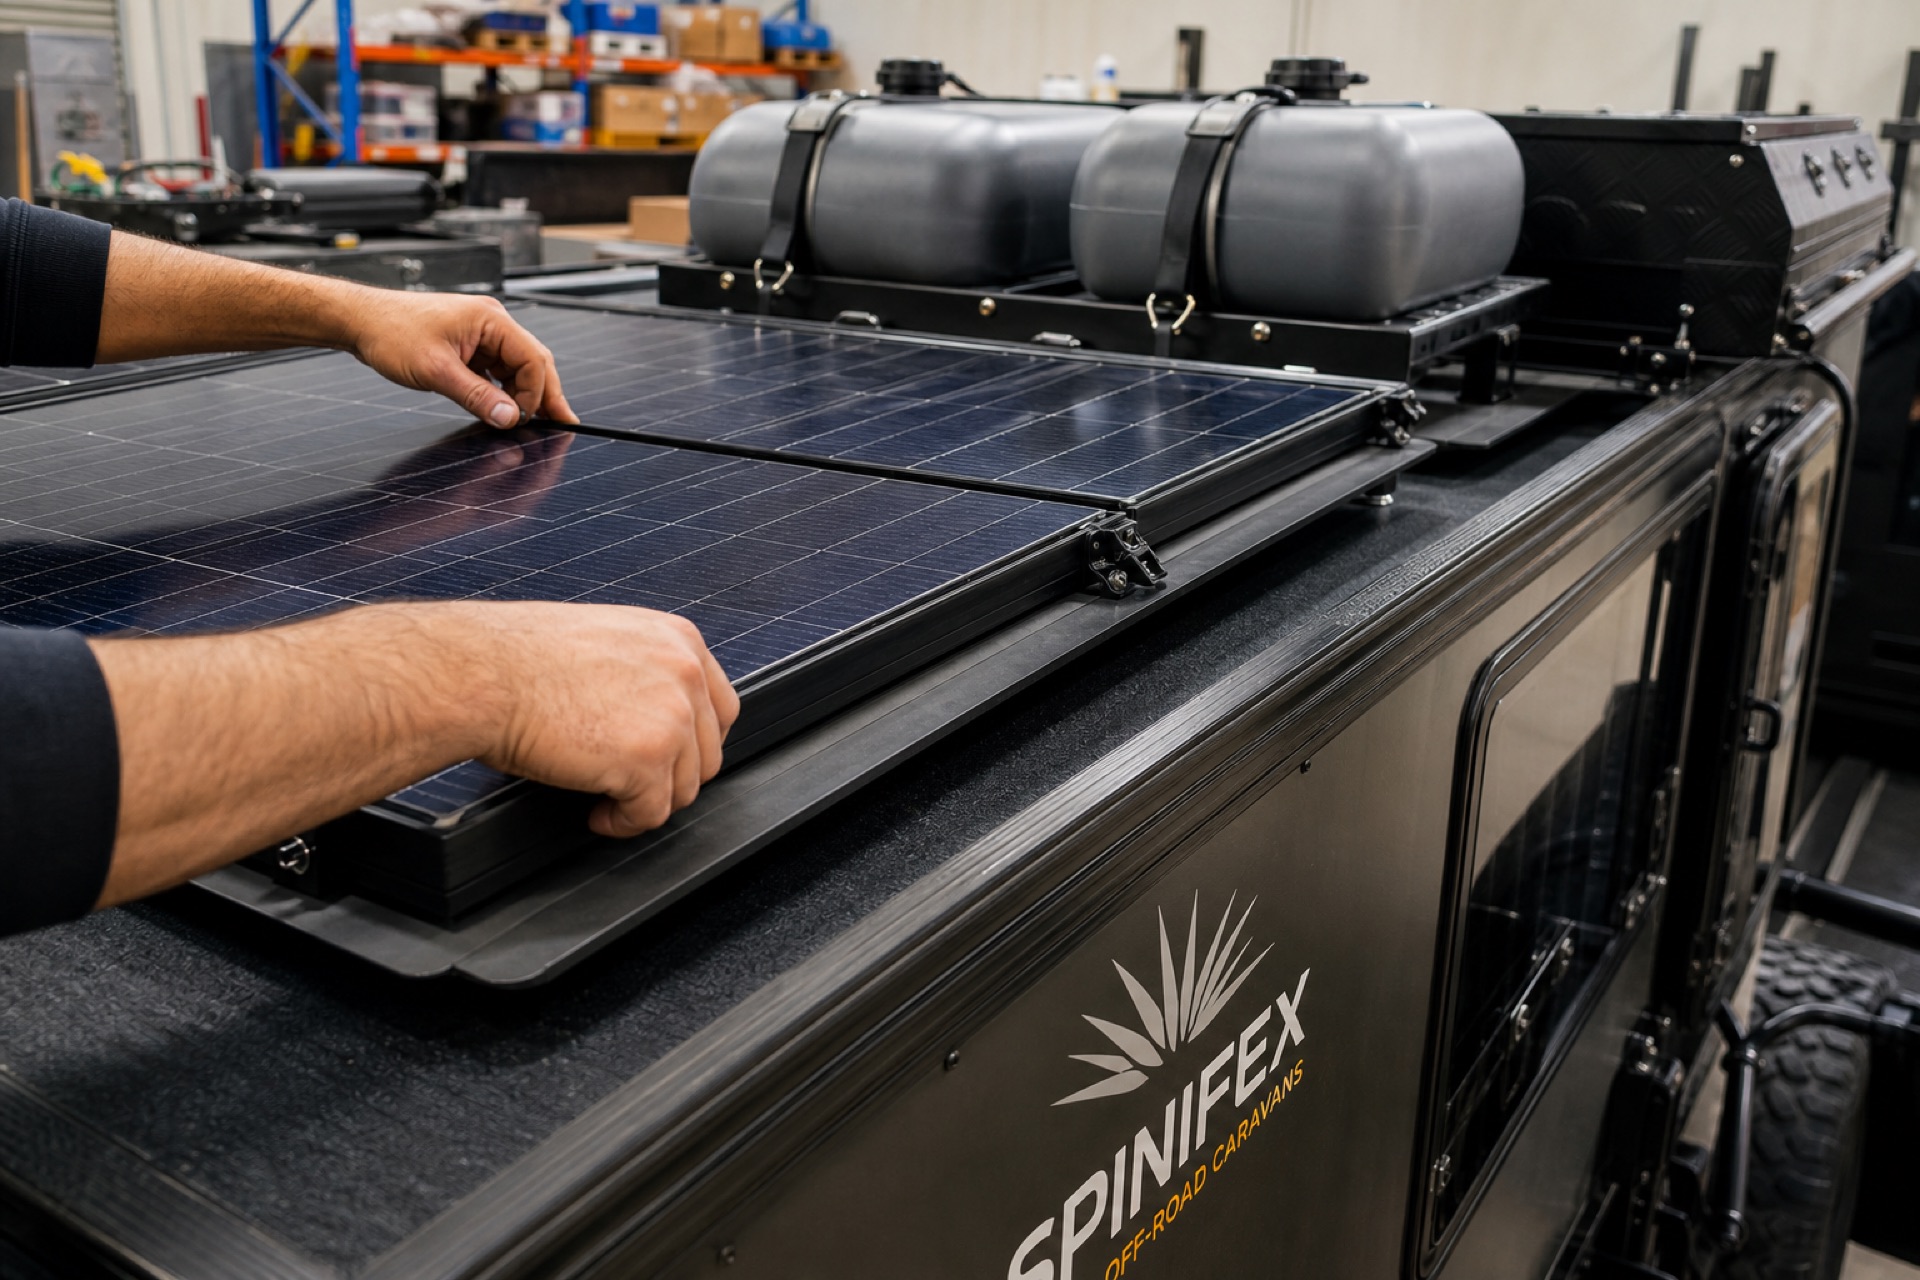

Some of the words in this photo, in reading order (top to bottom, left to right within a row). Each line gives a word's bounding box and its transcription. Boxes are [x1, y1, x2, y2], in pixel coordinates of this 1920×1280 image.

[1007, 967, 1311, 1280] SPINIFEX
[1104, 1164, 1208, 1280] OFF-ROAD
[1212, 1058, 1304, 1173] CARAVANS
